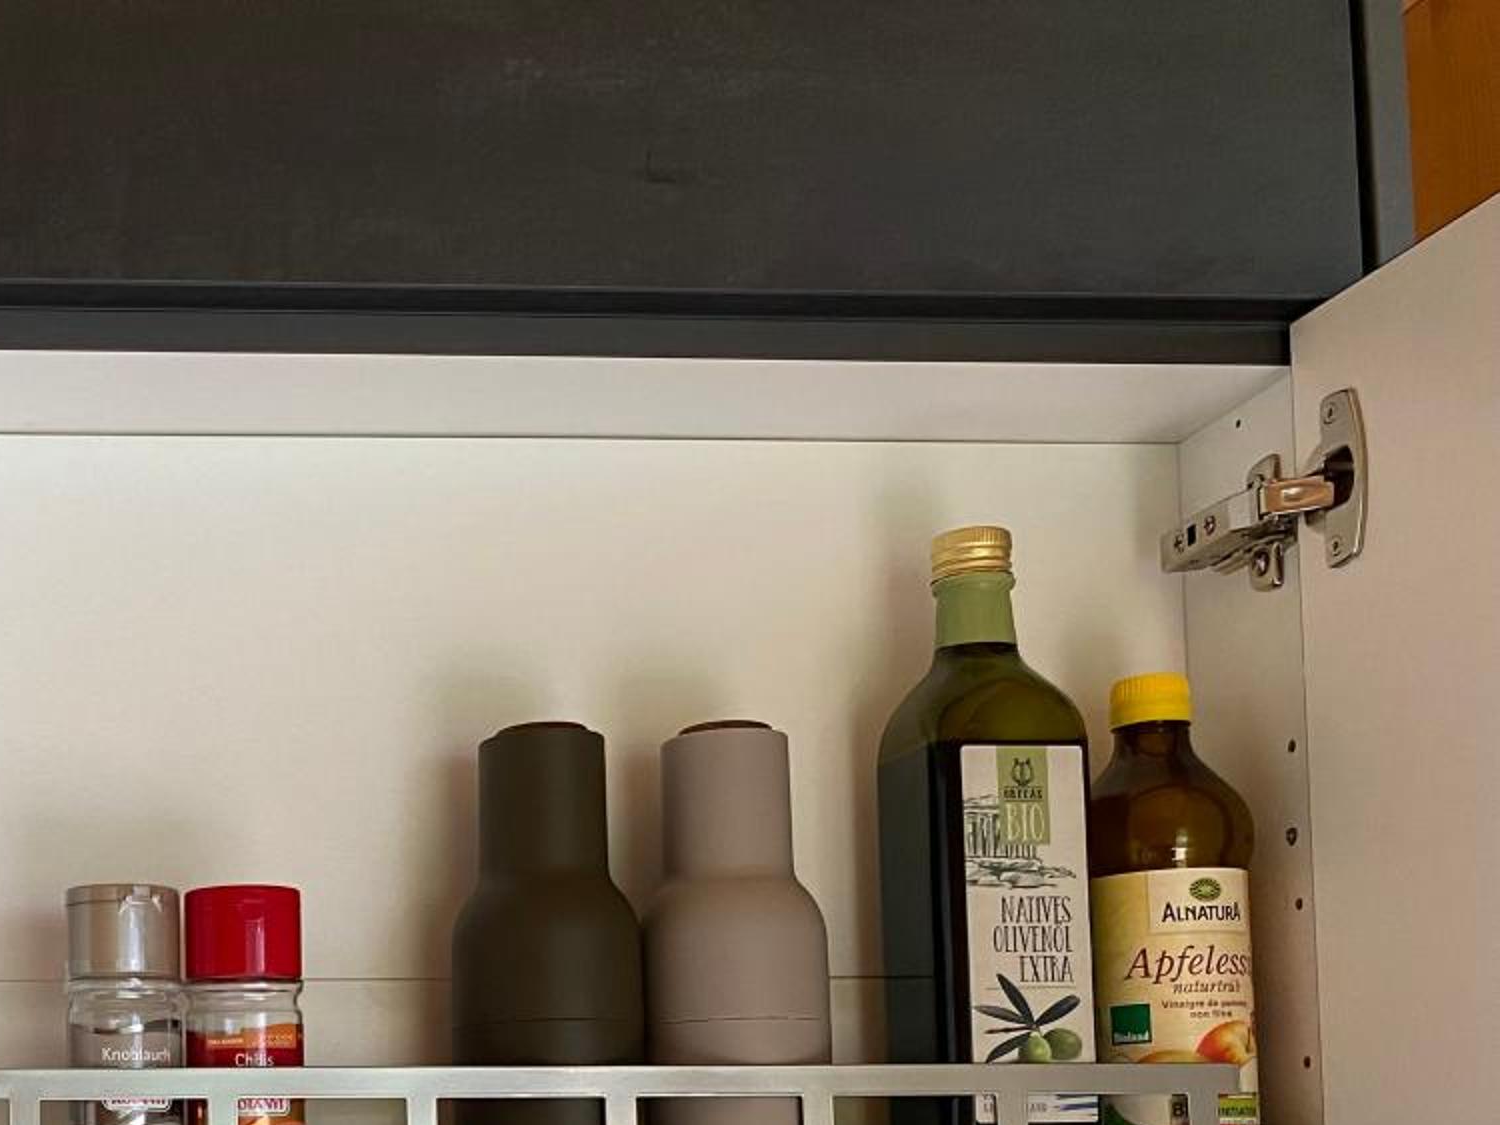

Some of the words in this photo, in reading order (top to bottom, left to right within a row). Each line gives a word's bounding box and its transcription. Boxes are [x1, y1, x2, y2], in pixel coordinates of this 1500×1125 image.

[1006, 802, 1045, 841] BIO
[1001, 895, 1072, 923] NATIVES
[1162, 902, 1241, 923] ALNATURA
[1020, 955, 1075, 983] EXTRA
[101, 1048, 172, 1062] Knoblauch
